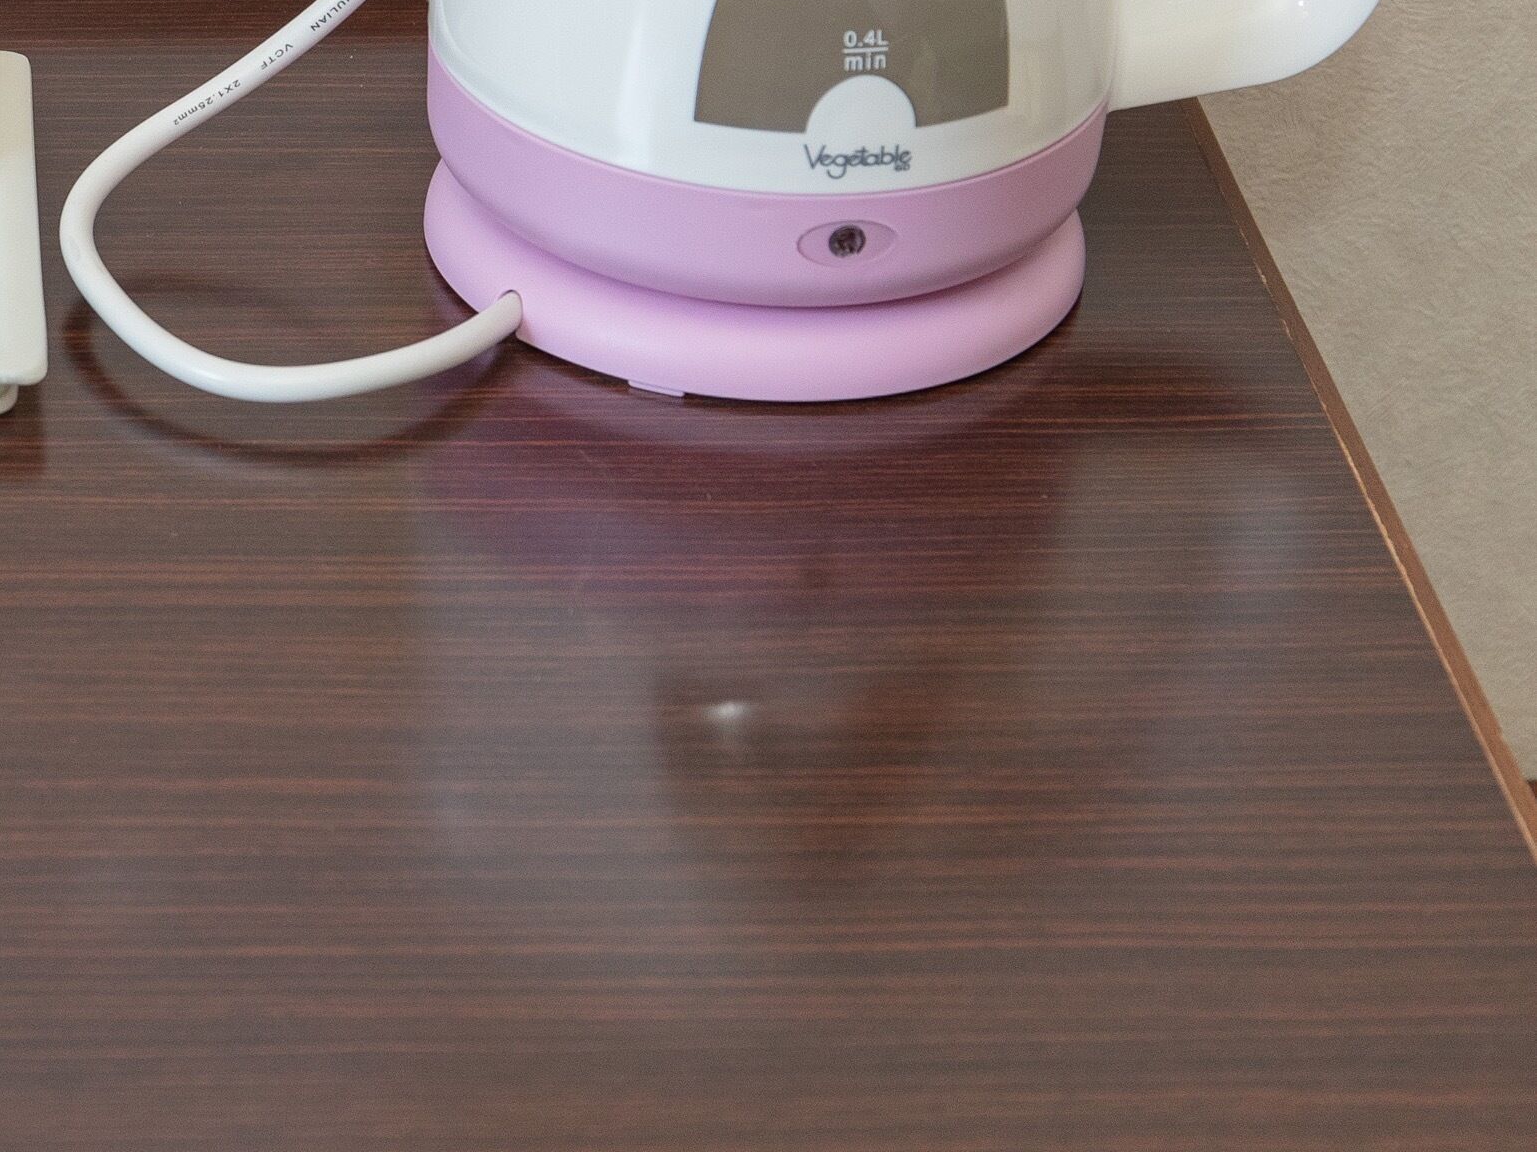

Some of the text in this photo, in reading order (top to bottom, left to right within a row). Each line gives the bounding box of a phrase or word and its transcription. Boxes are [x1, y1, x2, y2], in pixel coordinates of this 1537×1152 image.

[843, 29, 889, 48] 0.4L
[260, 43, 294, 70] VCTF
[844, 52, 886, 71] min
[804, 144, 912, 179] Vegetable
